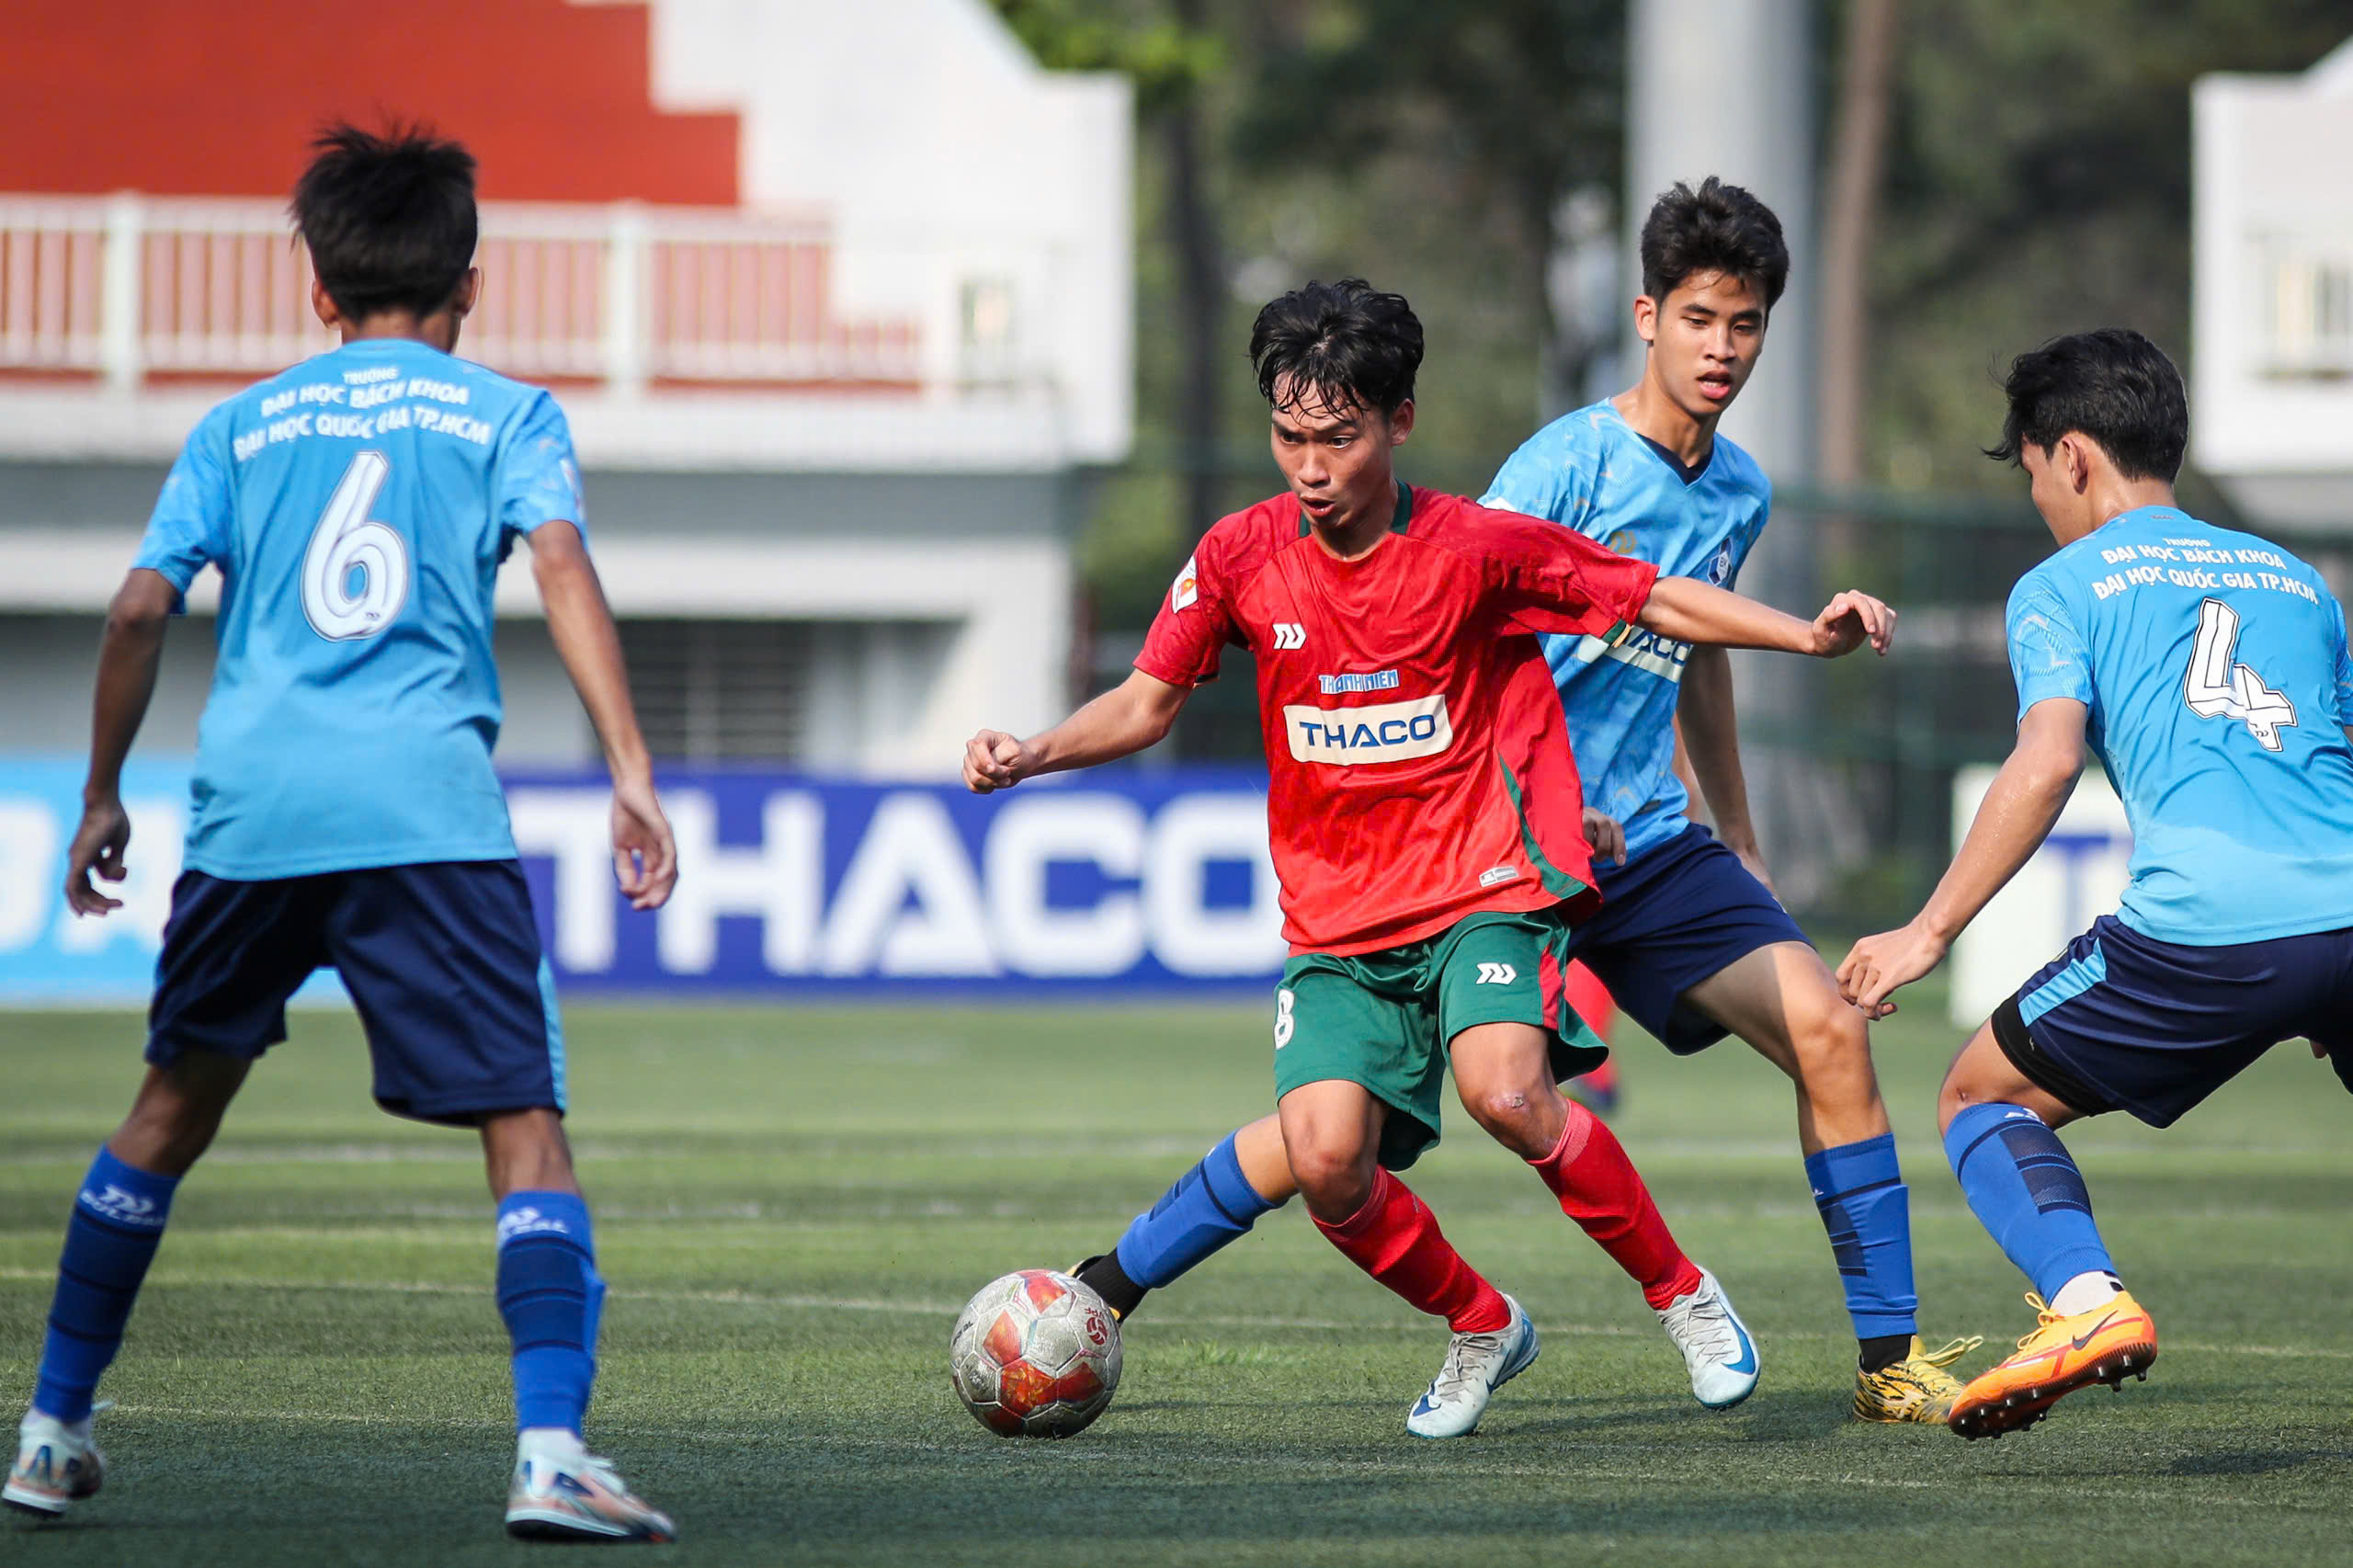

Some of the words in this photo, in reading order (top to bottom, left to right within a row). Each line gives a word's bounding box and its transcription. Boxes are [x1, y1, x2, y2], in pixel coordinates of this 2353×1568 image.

[407, 378, 470, 405] KHOA
[376, 407, 411, 434] GIA
[413, 404, 492, 446] TP.HCM
[300, 450, 409, 642] 6
[2100, 545, 2139, 565] ĐẠI
[2137, 544, 2181, 563] HỌC
[2180, 548, 2234, 564] BÁCH
[2234, 549, 2288, 571] KHOA
[2091, 573, 2128, 600] ĐẠI
[2125, 565, 2167, 586] HỌC
[2168, 567, 2221, 589] QUỐC
[2222, 573, 2258, 589] GIA
[2257, 572, 2319, 606] TP.HCM
[2183, 597, 2298, 752] 4
[1299, 714, 1436, 749] THACO
[508, 788, 1284, 978] THACO
[1274, 988, 1295, 1051] 8
